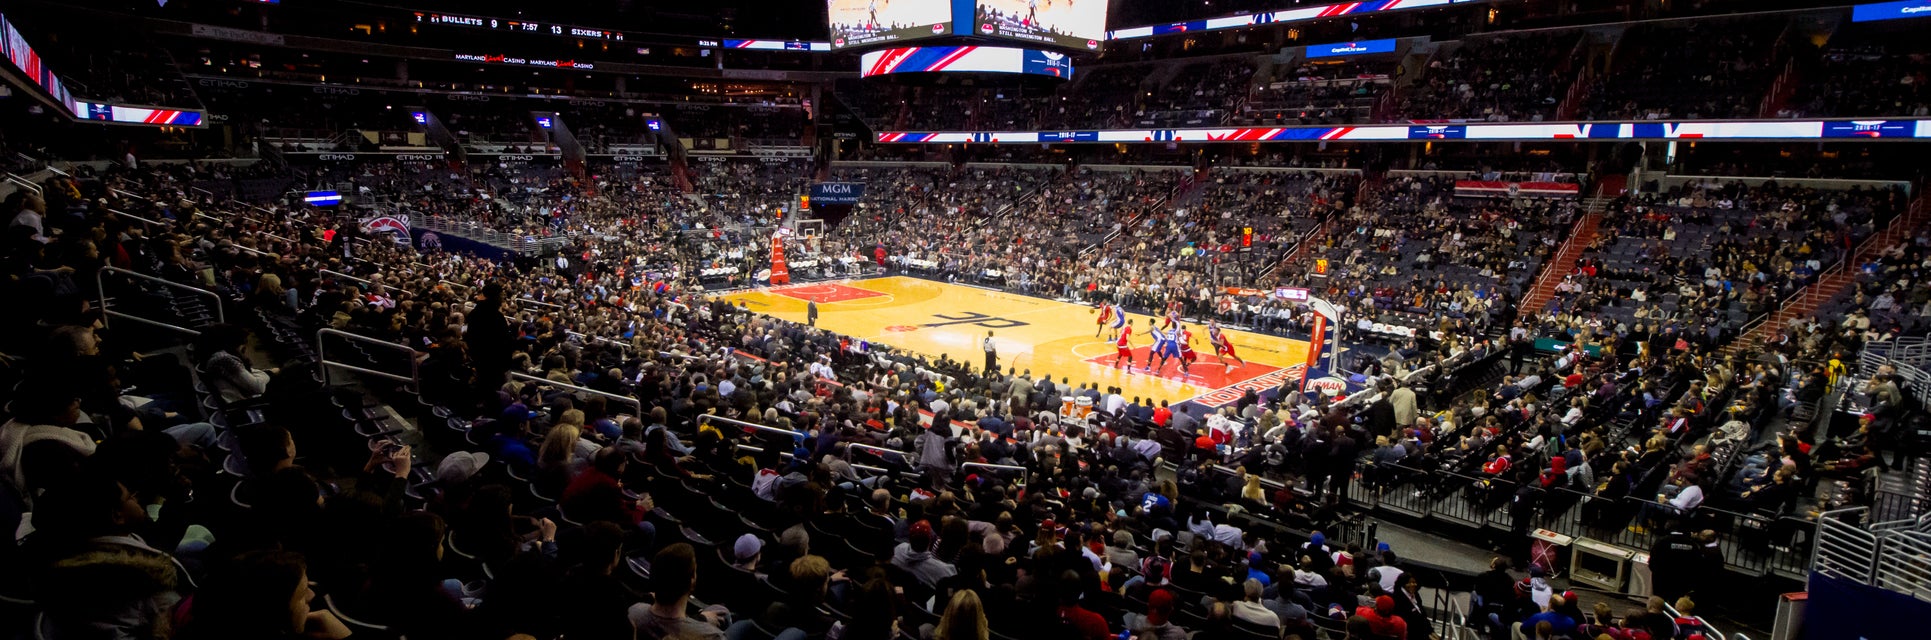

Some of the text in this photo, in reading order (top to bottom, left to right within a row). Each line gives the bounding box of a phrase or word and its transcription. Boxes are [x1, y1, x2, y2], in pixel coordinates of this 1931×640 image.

[442, 15, 483, 26] BULLETS
[491, 19, 498, 28] 9
[522, 22, 538, 31] 7:57
[551, 26, 562, 34] 13
[571, 28, 602, 37] SIXERS
[998, 29, 1013, 37] STILL
[1014, 33, 1043, 41] WASHINGTON
[504, 57, 525, 65] CASINO
[530, 59, 557, 67] MARYLAND
[199, 79, 249, 89] ETIHAD
[313, 86, 360, 96] ETIHAD
[447, 94, 490, 102] ETIHAD
[822, 184, 851, 193] MGM
